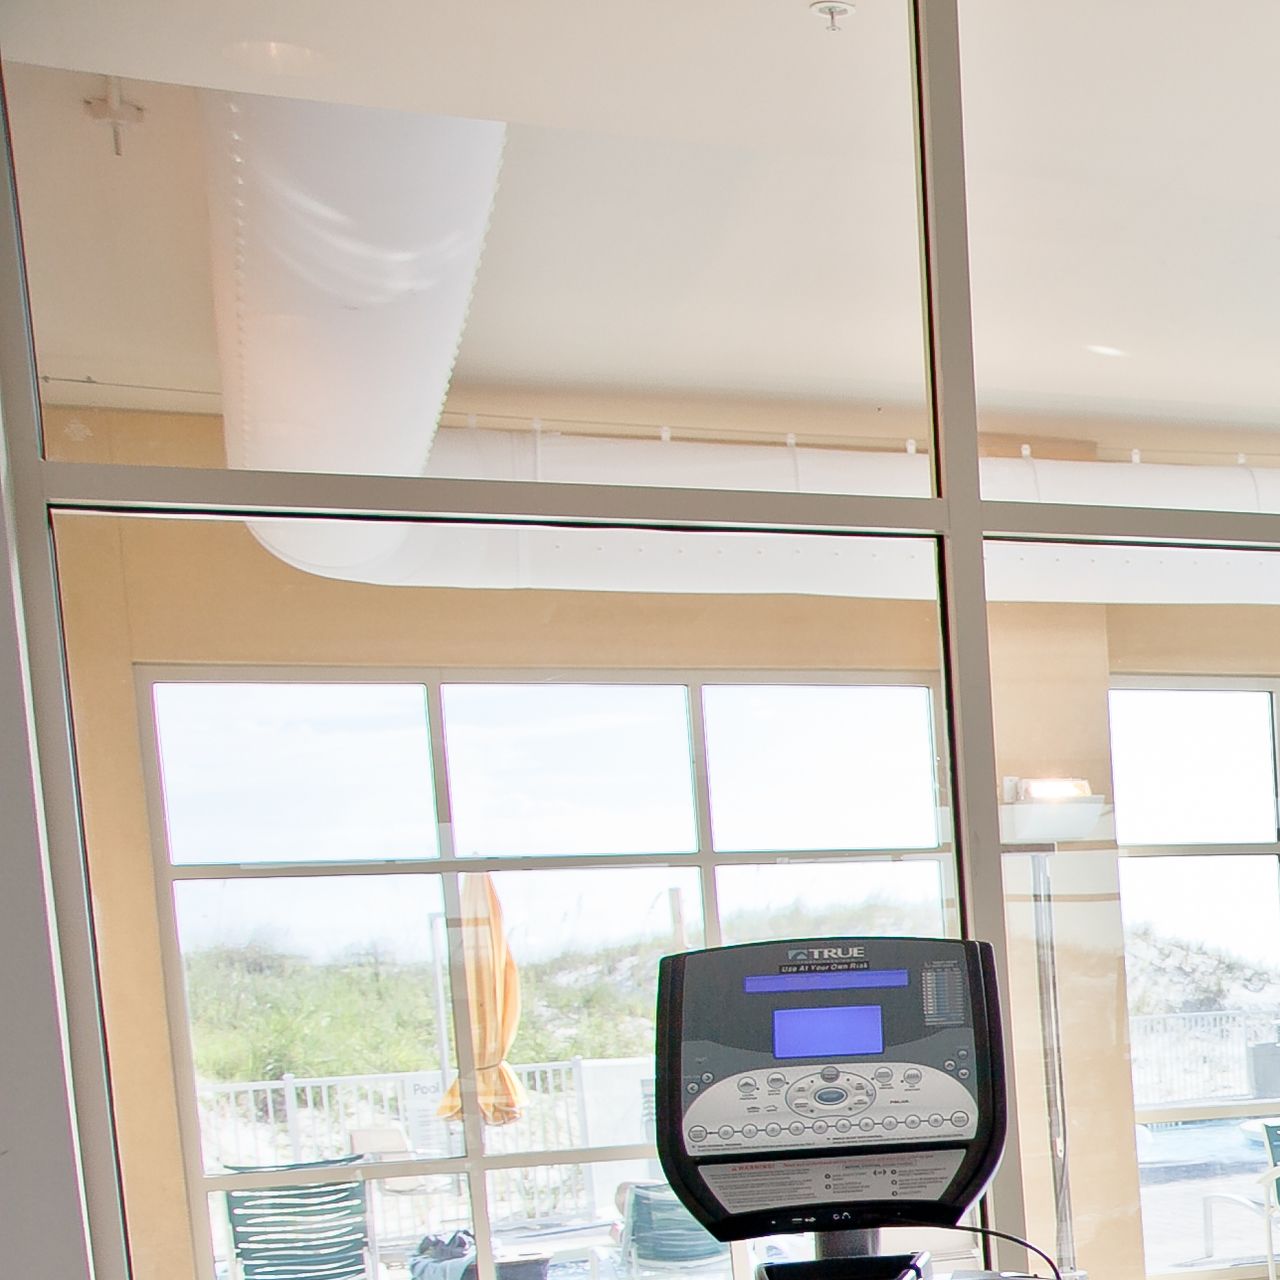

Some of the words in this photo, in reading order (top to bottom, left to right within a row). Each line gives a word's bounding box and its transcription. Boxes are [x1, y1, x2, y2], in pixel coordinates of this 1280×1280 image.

[808, 946, 865, 960] TRUE
[831, 963, 848, 971] Own
[413, 1082, 440, 1095] Pool
